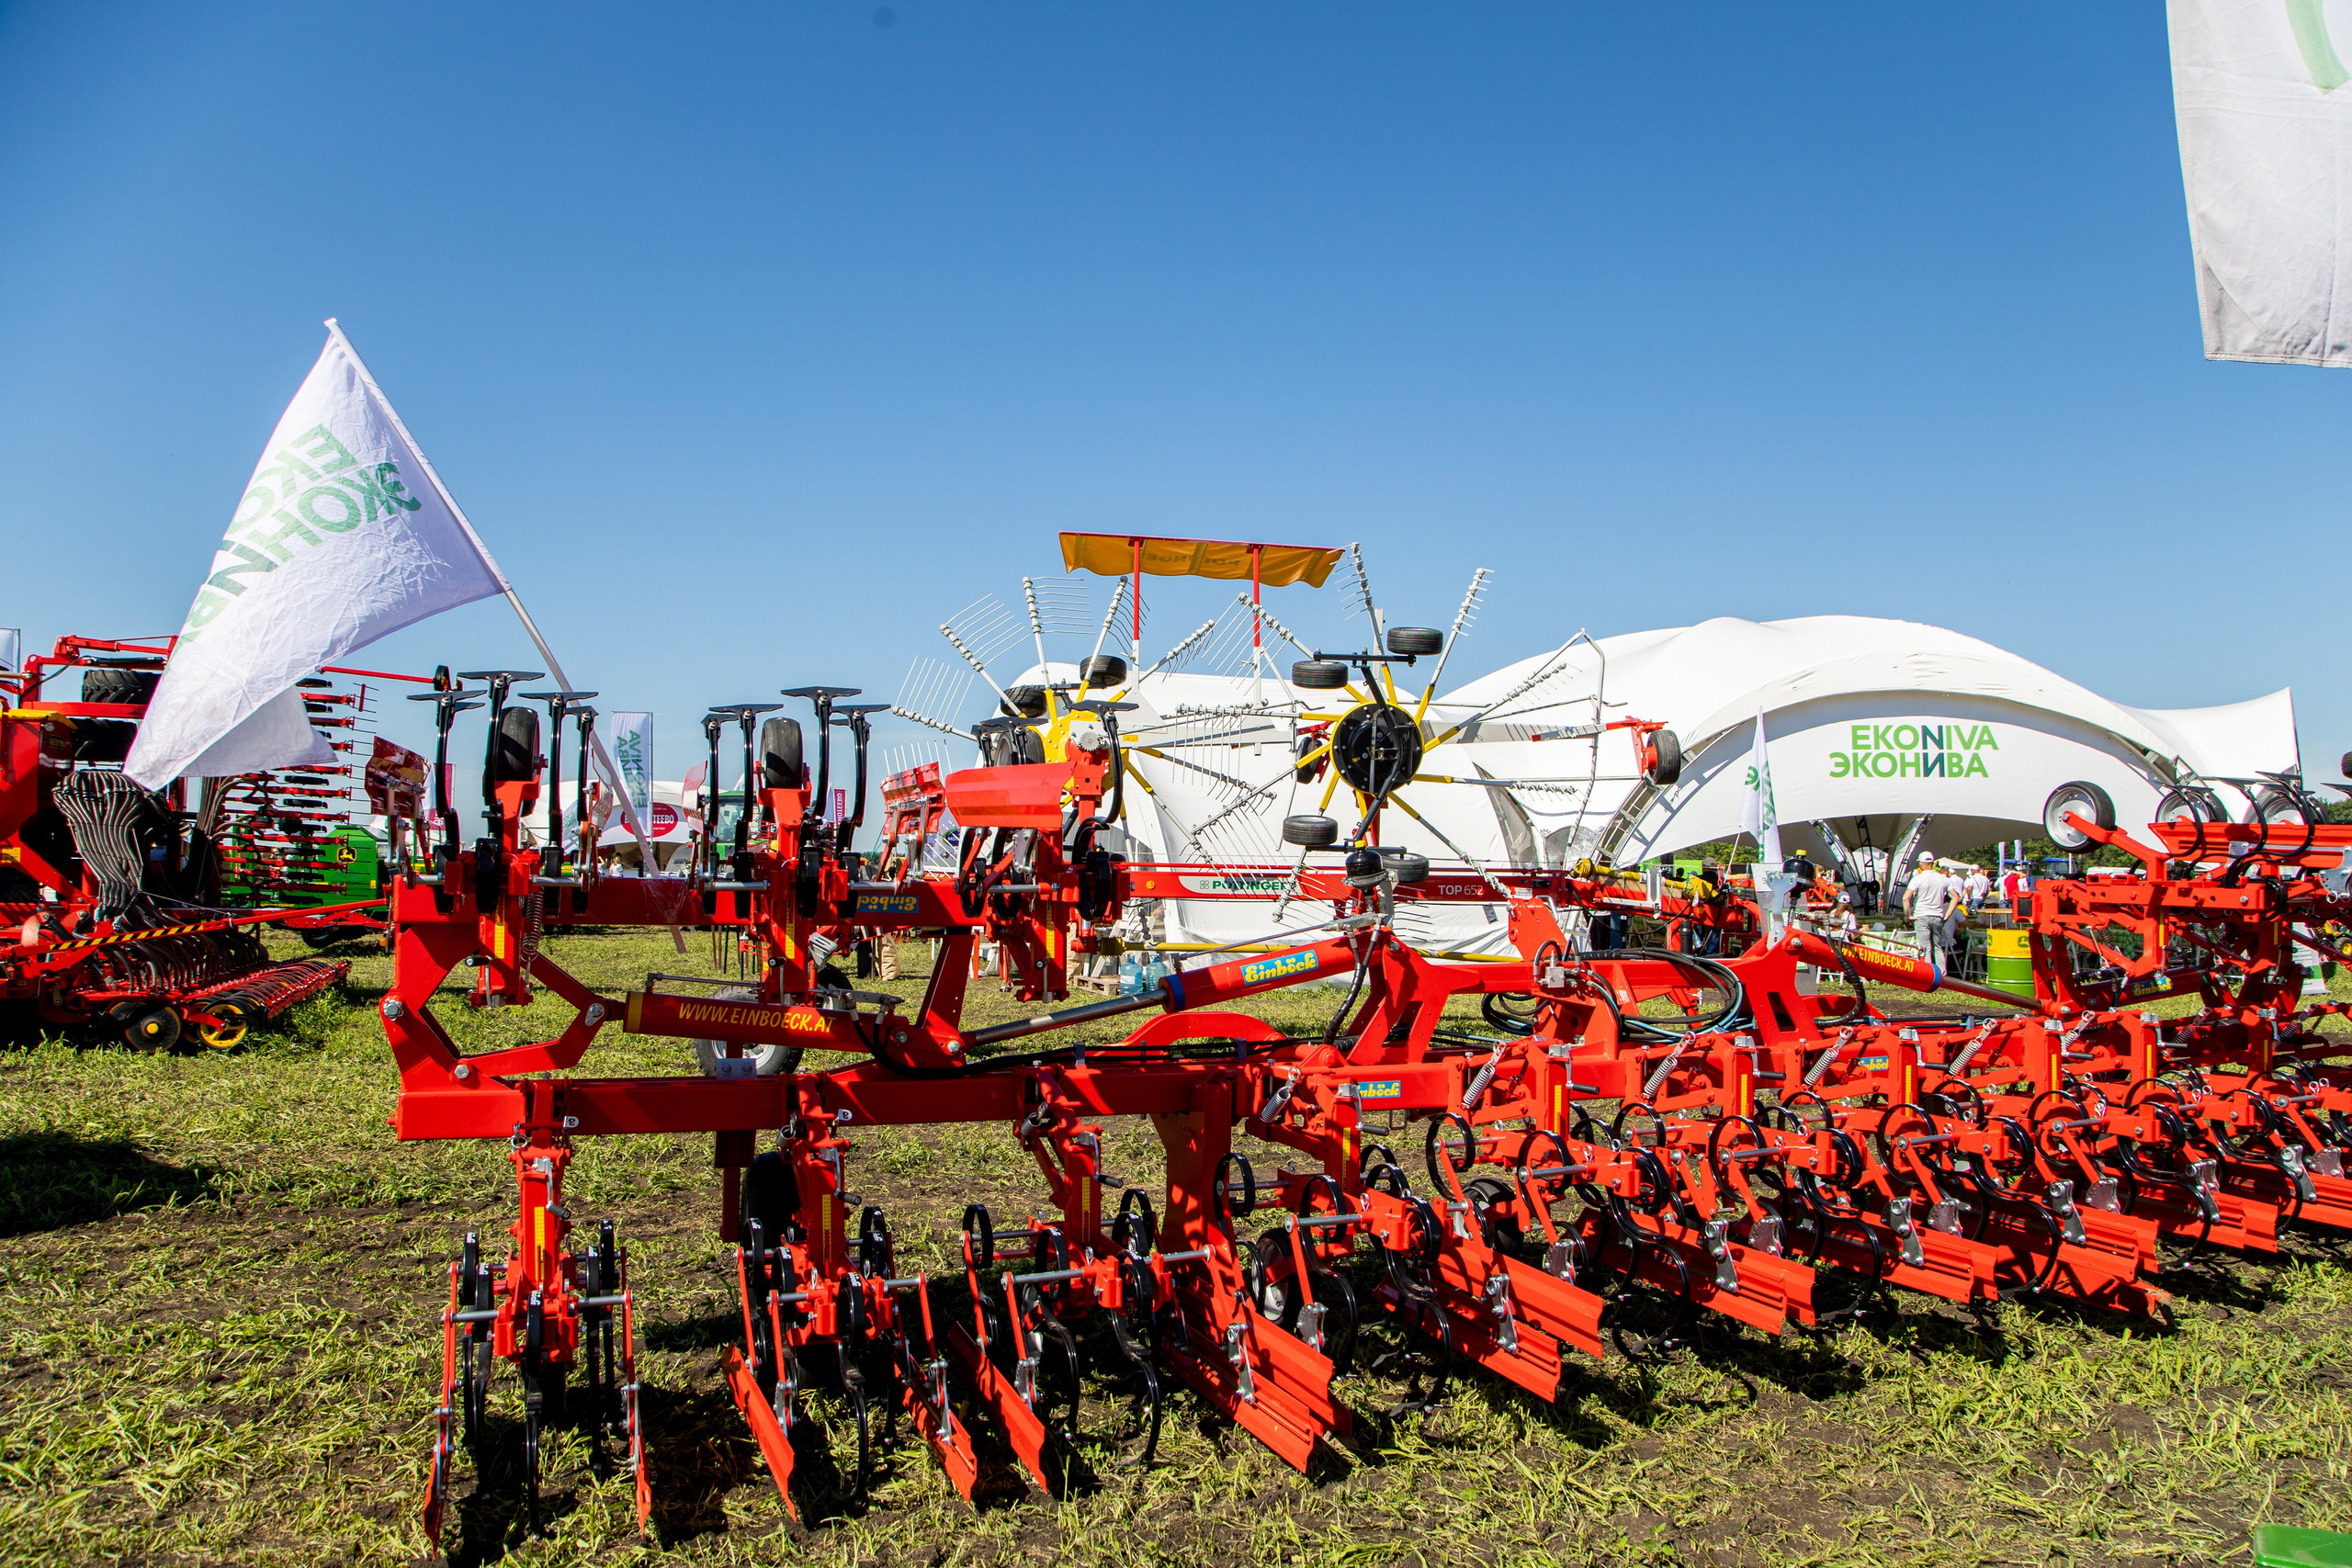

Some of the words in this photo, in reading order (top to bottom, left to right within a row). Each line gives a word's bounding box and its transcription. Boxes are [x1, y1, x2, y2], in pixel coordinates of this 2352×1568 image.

[1850, 724, 1999, 750] EKONIVA
[1828, 751, 1989, 778] ЭКОНИВА
[1438, 885, 1463, 896] TOP
[1464, 885, 1484, 896] 652
[1244, 951, 1317, 984] Einböck
[678, 1002, 837, 1032] WWW.EINBOECK.AT
